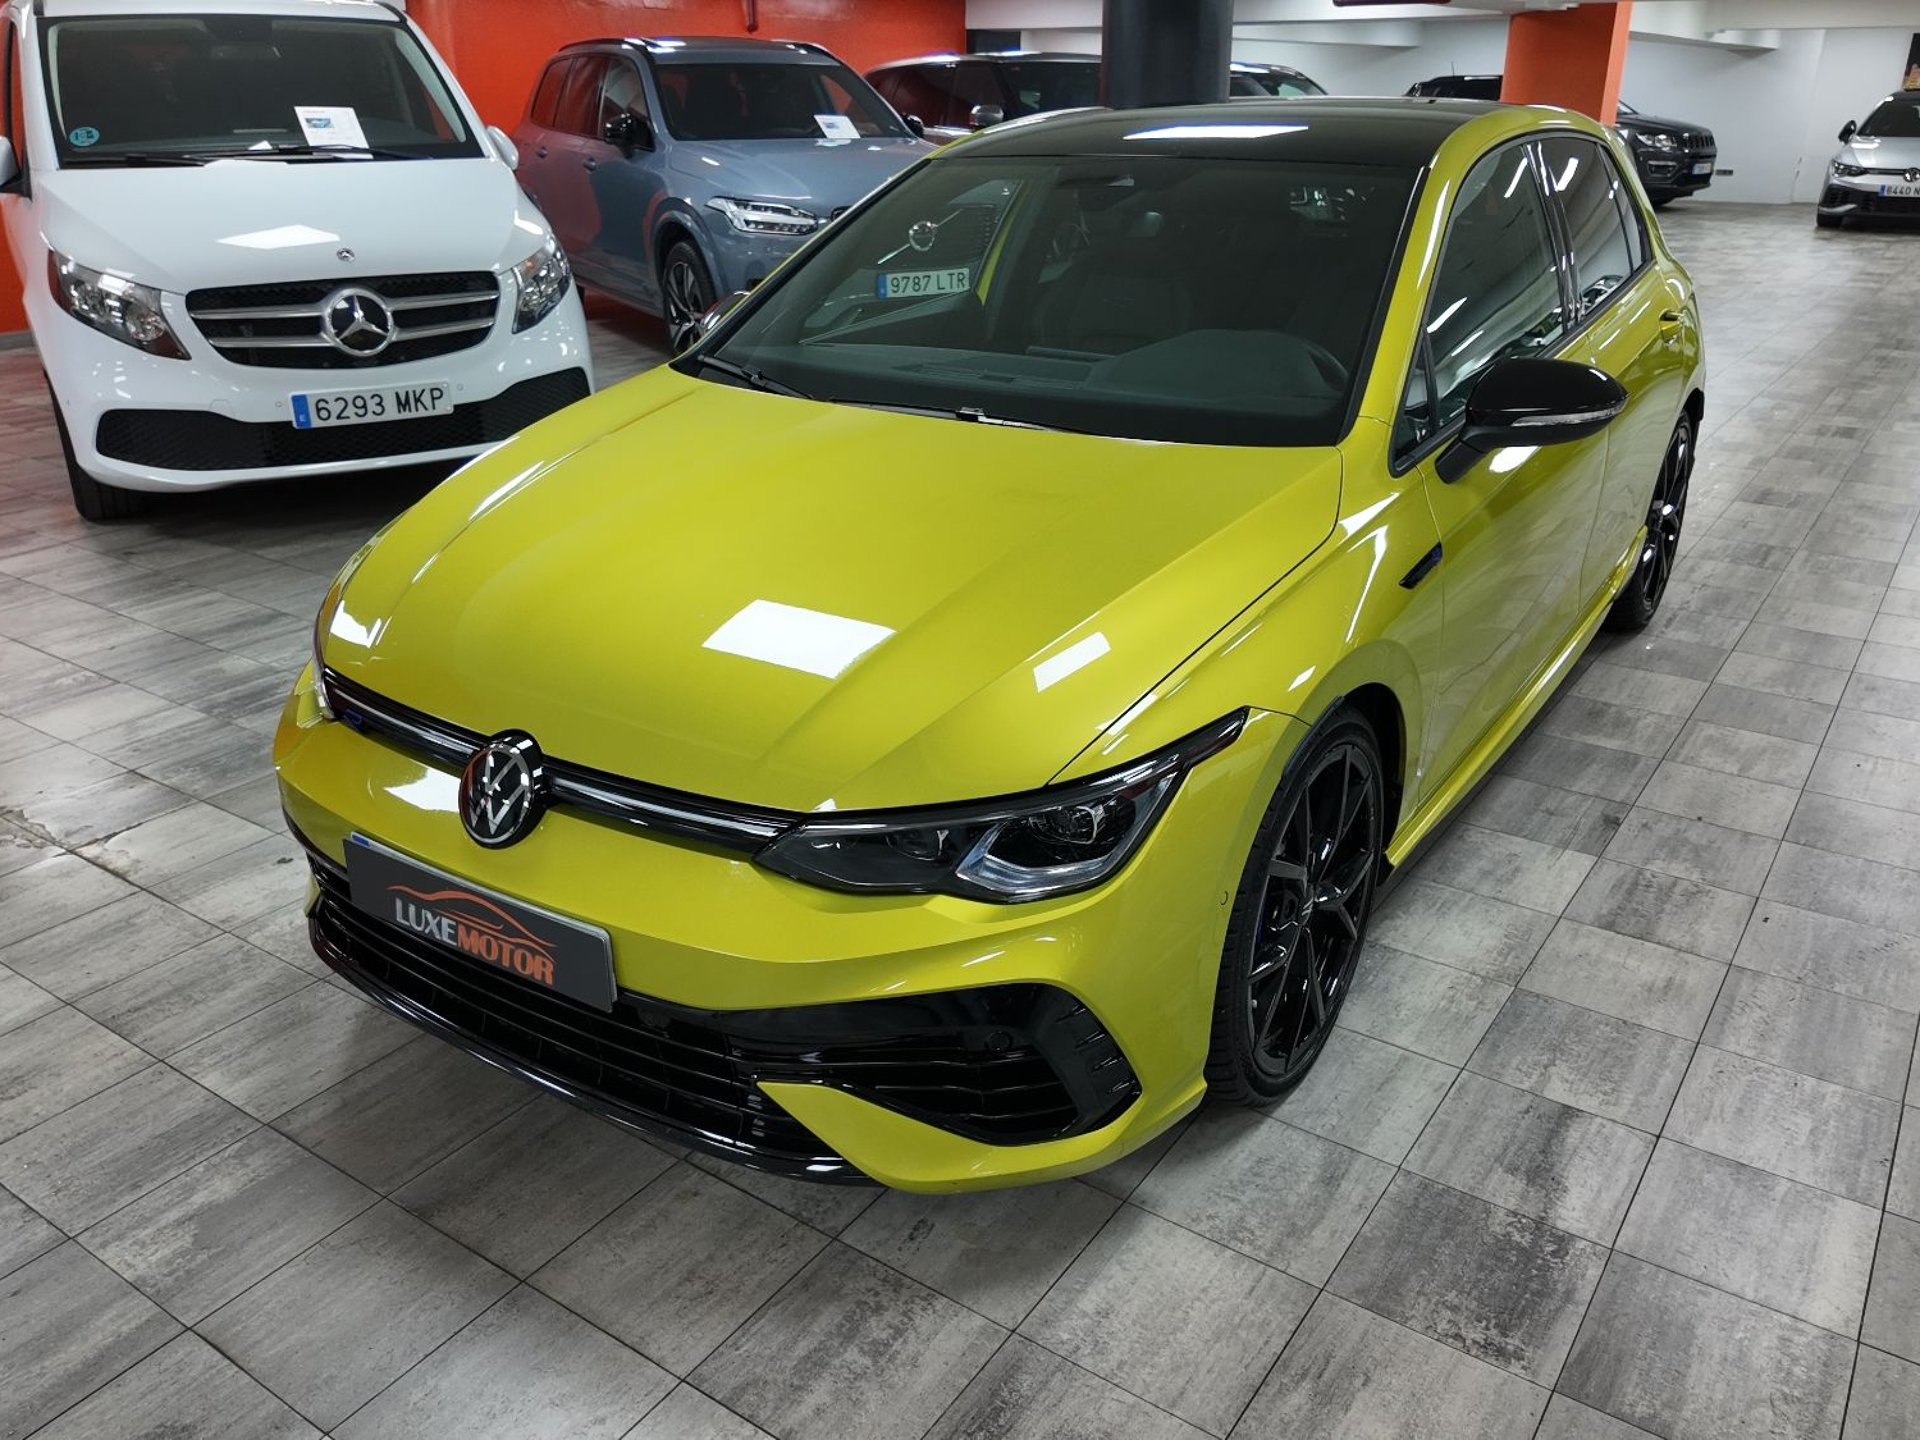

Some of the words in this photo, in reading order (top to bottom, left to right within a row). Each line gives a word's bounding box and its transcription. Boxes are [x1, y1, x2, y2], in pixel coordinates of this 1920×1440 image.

[890, 274, 931, 294] 9787
[936, 272, 966, 290] LTR
[315, 393, 386, 422] 6293
[395, 387, 444, 414] MKP
[395, 897, 555, 986] LUXEMOTOR
